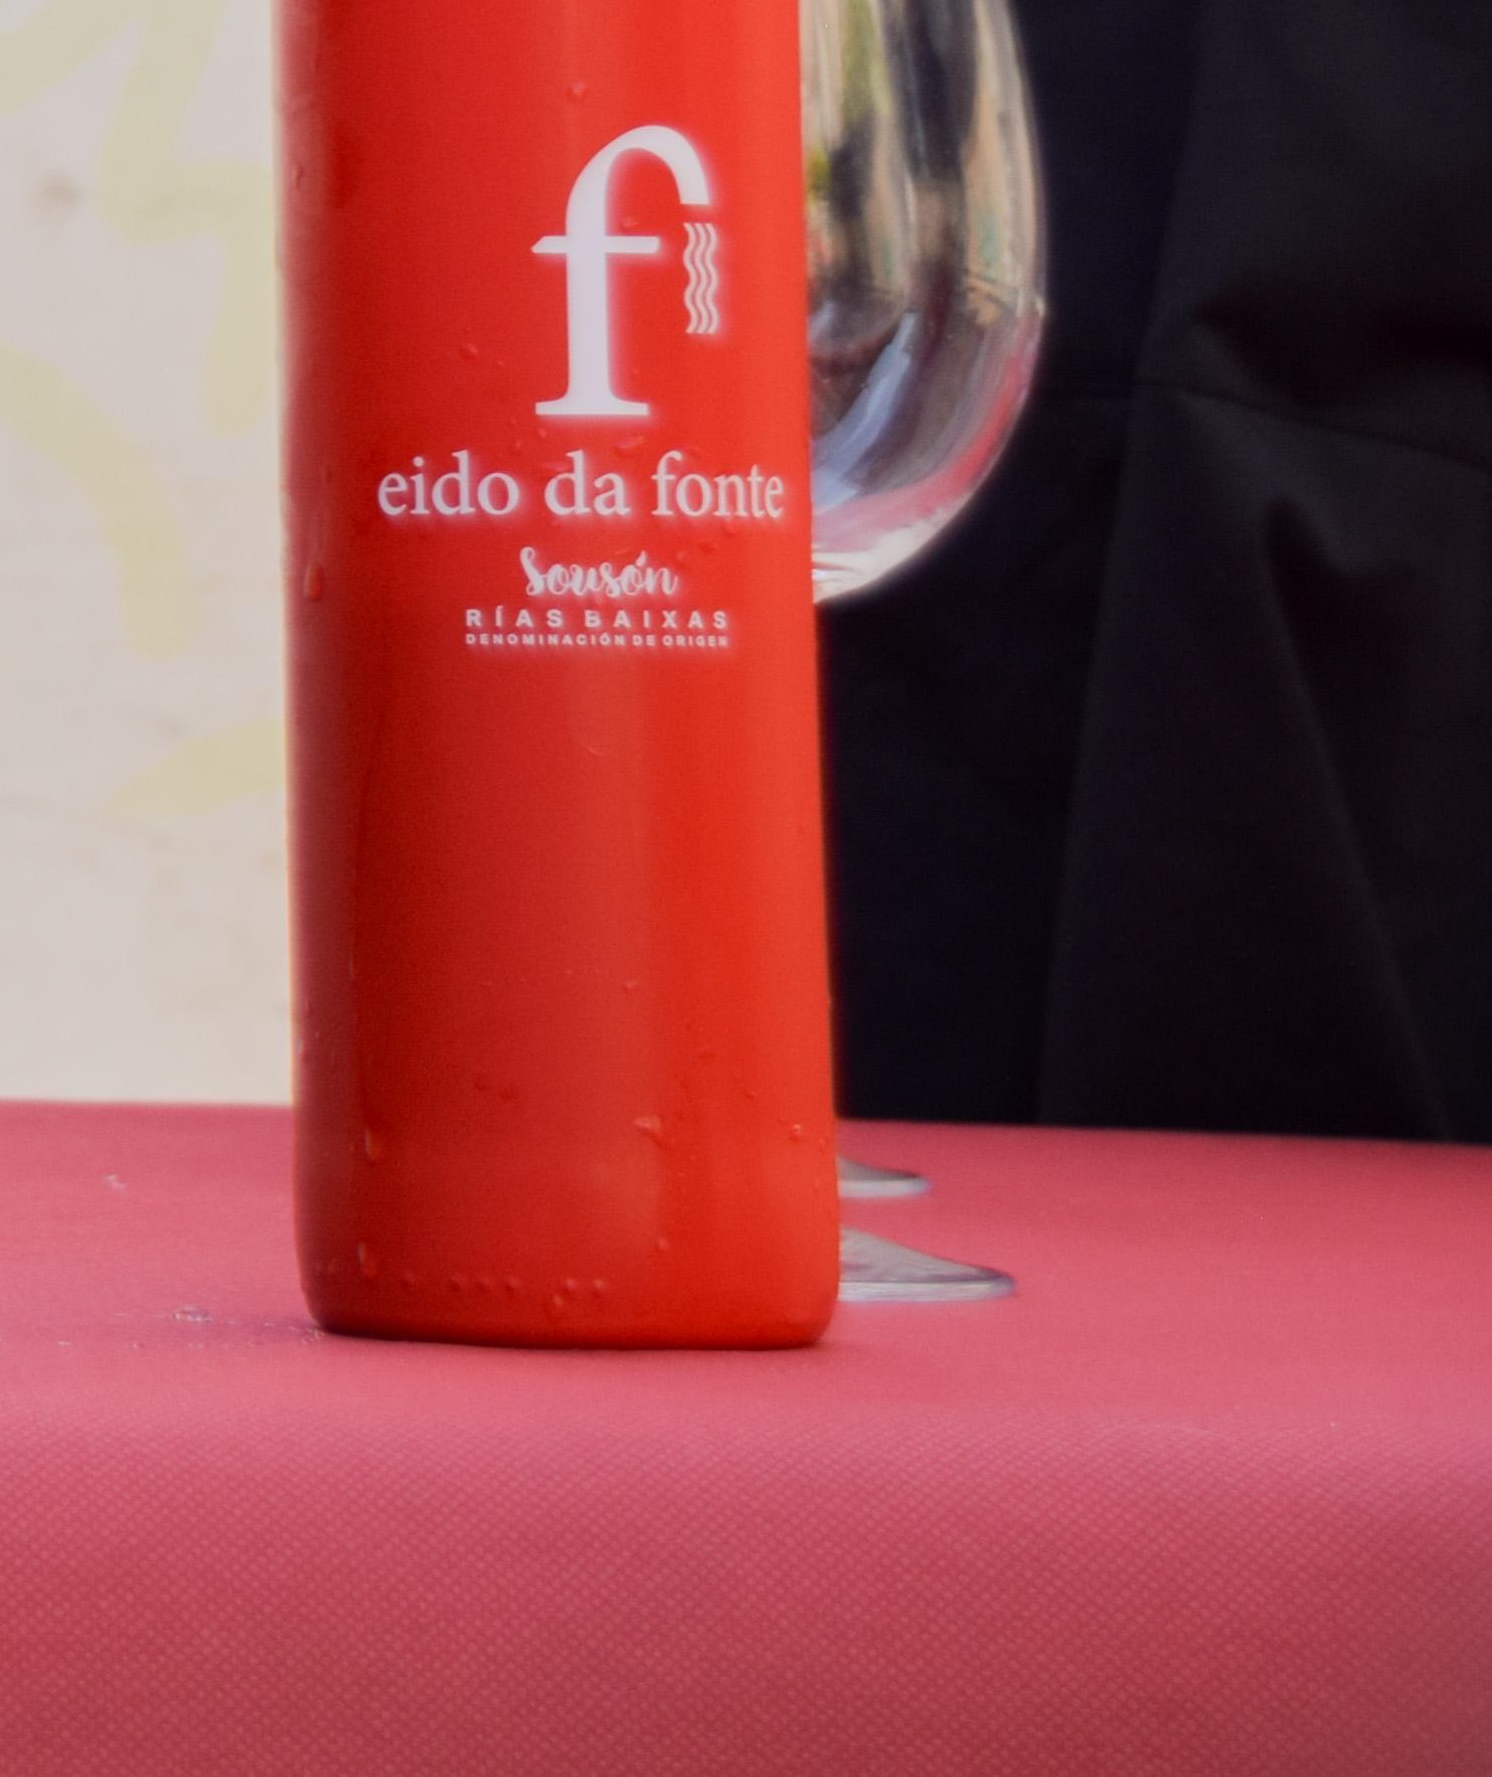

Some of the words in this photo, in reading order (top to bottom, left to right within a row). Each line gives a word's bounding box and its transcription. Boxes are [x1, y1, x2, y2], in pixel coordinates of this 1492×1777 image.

[377, 448, 520, 518] eido
[543, 449, 632, 518] da
[651, 449, 785, 519] fonte
[519, 546, 679, 598] Sousón
[465, 605, 564, 629] RÍAS
[583, 609, 729, 630] BAIXAS
[465, 632, 626, 647] DENOMINACIÓN
[632, 633, 655, 647] DE
[662, 634, 729, 648] ORIGEN
